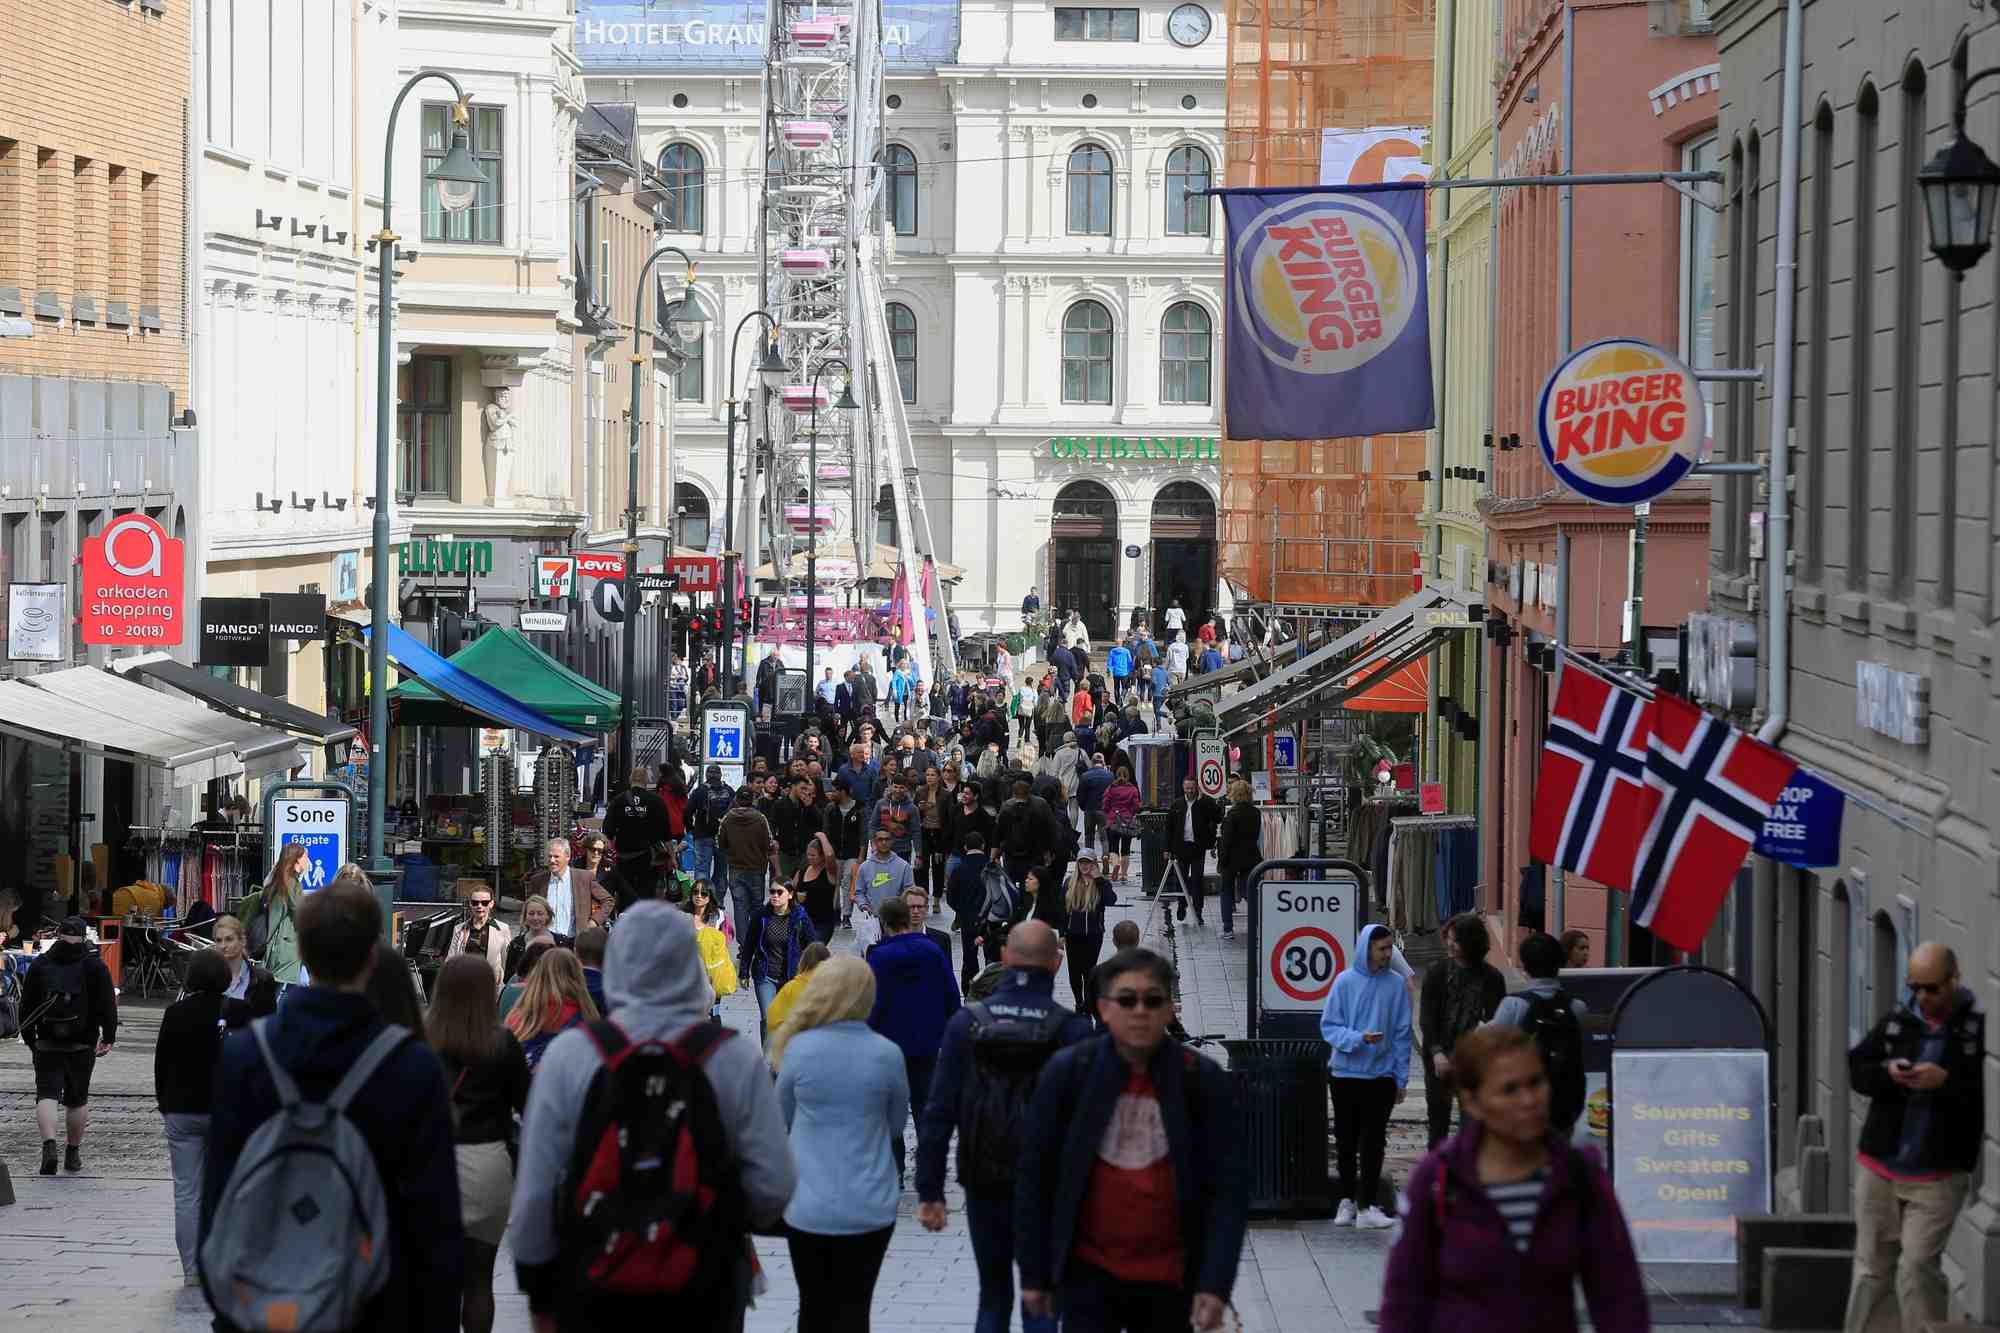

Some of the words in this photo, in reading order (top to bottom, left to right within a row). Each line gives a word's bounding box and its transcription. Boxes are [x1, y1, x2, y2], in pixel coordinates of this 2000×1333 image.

[684, 19, 768, 44] GRAN
[1267, 226, 1355, 351] KING
[1312, 217, 1382, 343] BURGER
[1554, 373, 1682, 420] BURGER
[1555, 401, 1687, 462] KING
[543, 562, 568, 597] 7
[97, 585, 168, 599] arkaden
[91, 603, 173, 620] shopping
[524, 616, 564, 626] MINIBANK
[100, 625, 113, 636] 10
[712, 712, 738, 723] Sone
[1200, 743, 1221, 754] Sone
[1204, 769, 1219, 785] 30
[286, 805, 335, 823] Sone
[1773, 804, 1799, 822] AX
[1762, 822, 1808, 840] FREE
[290, 834, 330, 847] Gågate
[1277, 890, 1341, 913] Sone
[1285, 946, 1333, 982] 30
[1631, 1103, 1751, 1121] Souvenirs
[1664, 1128, 1721, 1147] Gifts
[1633, 1157, 1749, 1175] Sweaters
[1657, 1183, 1729, 1204] Open!
